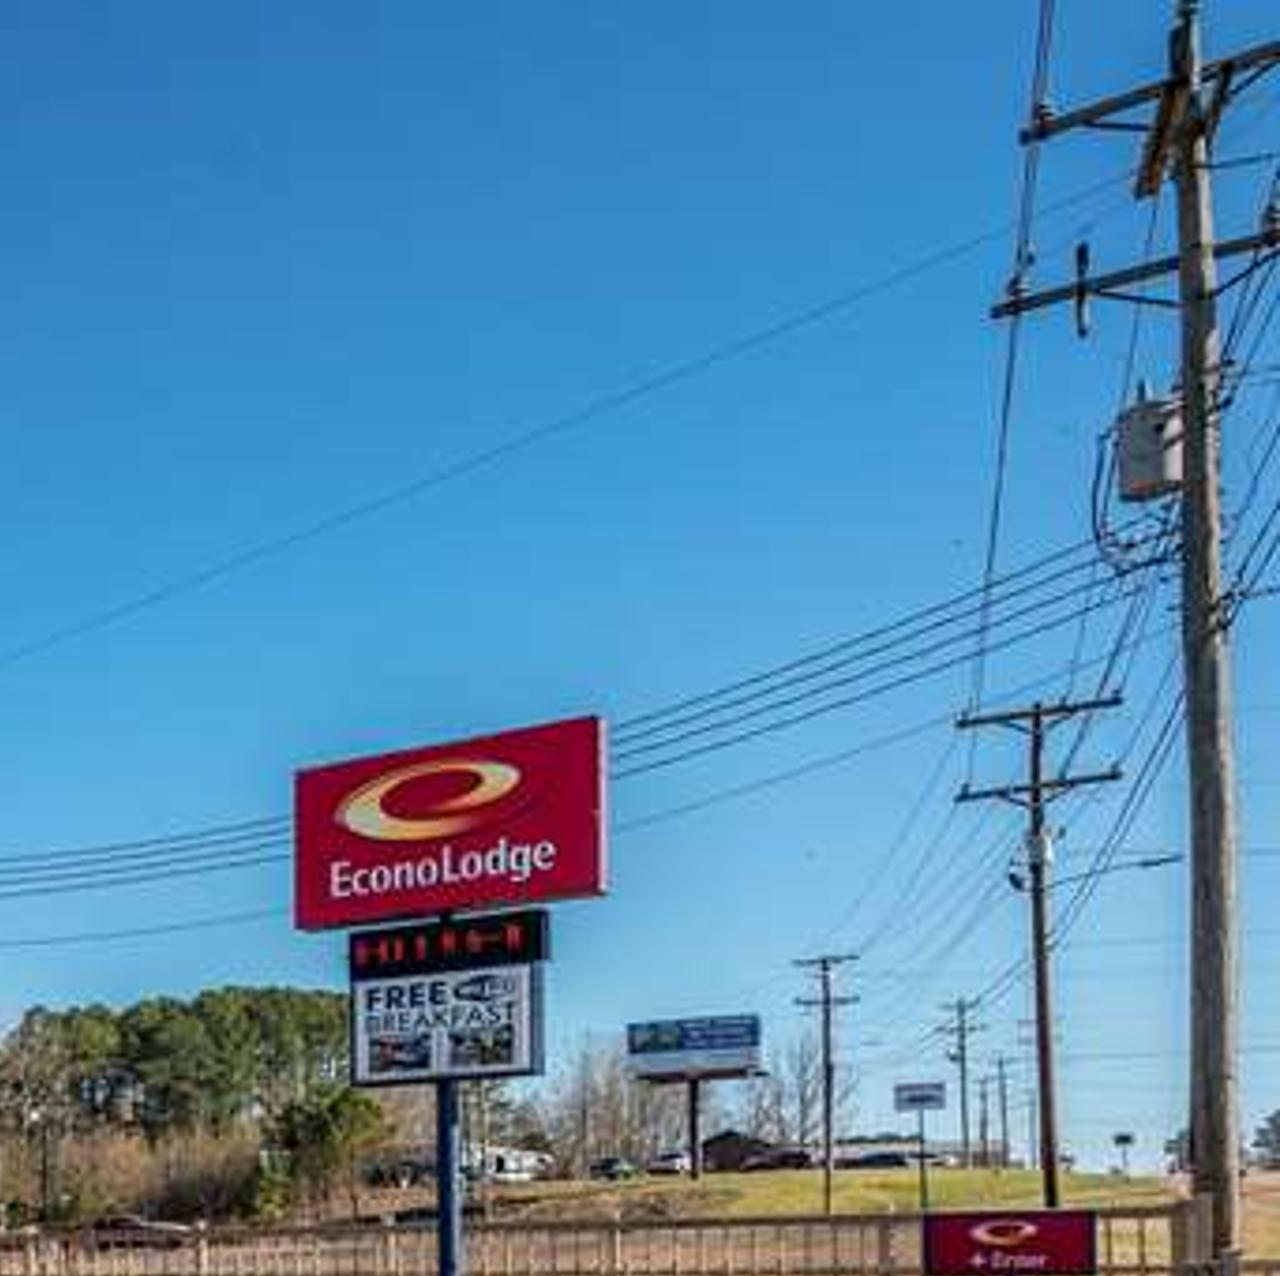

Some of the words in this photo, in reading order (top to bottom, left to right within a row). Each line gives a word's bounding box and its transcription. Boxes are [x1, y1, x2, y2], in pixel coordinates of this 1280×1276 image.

[329, 838, 557, 898] EconoLodge
[366, 981, 448, 1012] FREE
[364, 1001, 515, 1035] BREAKFAST
